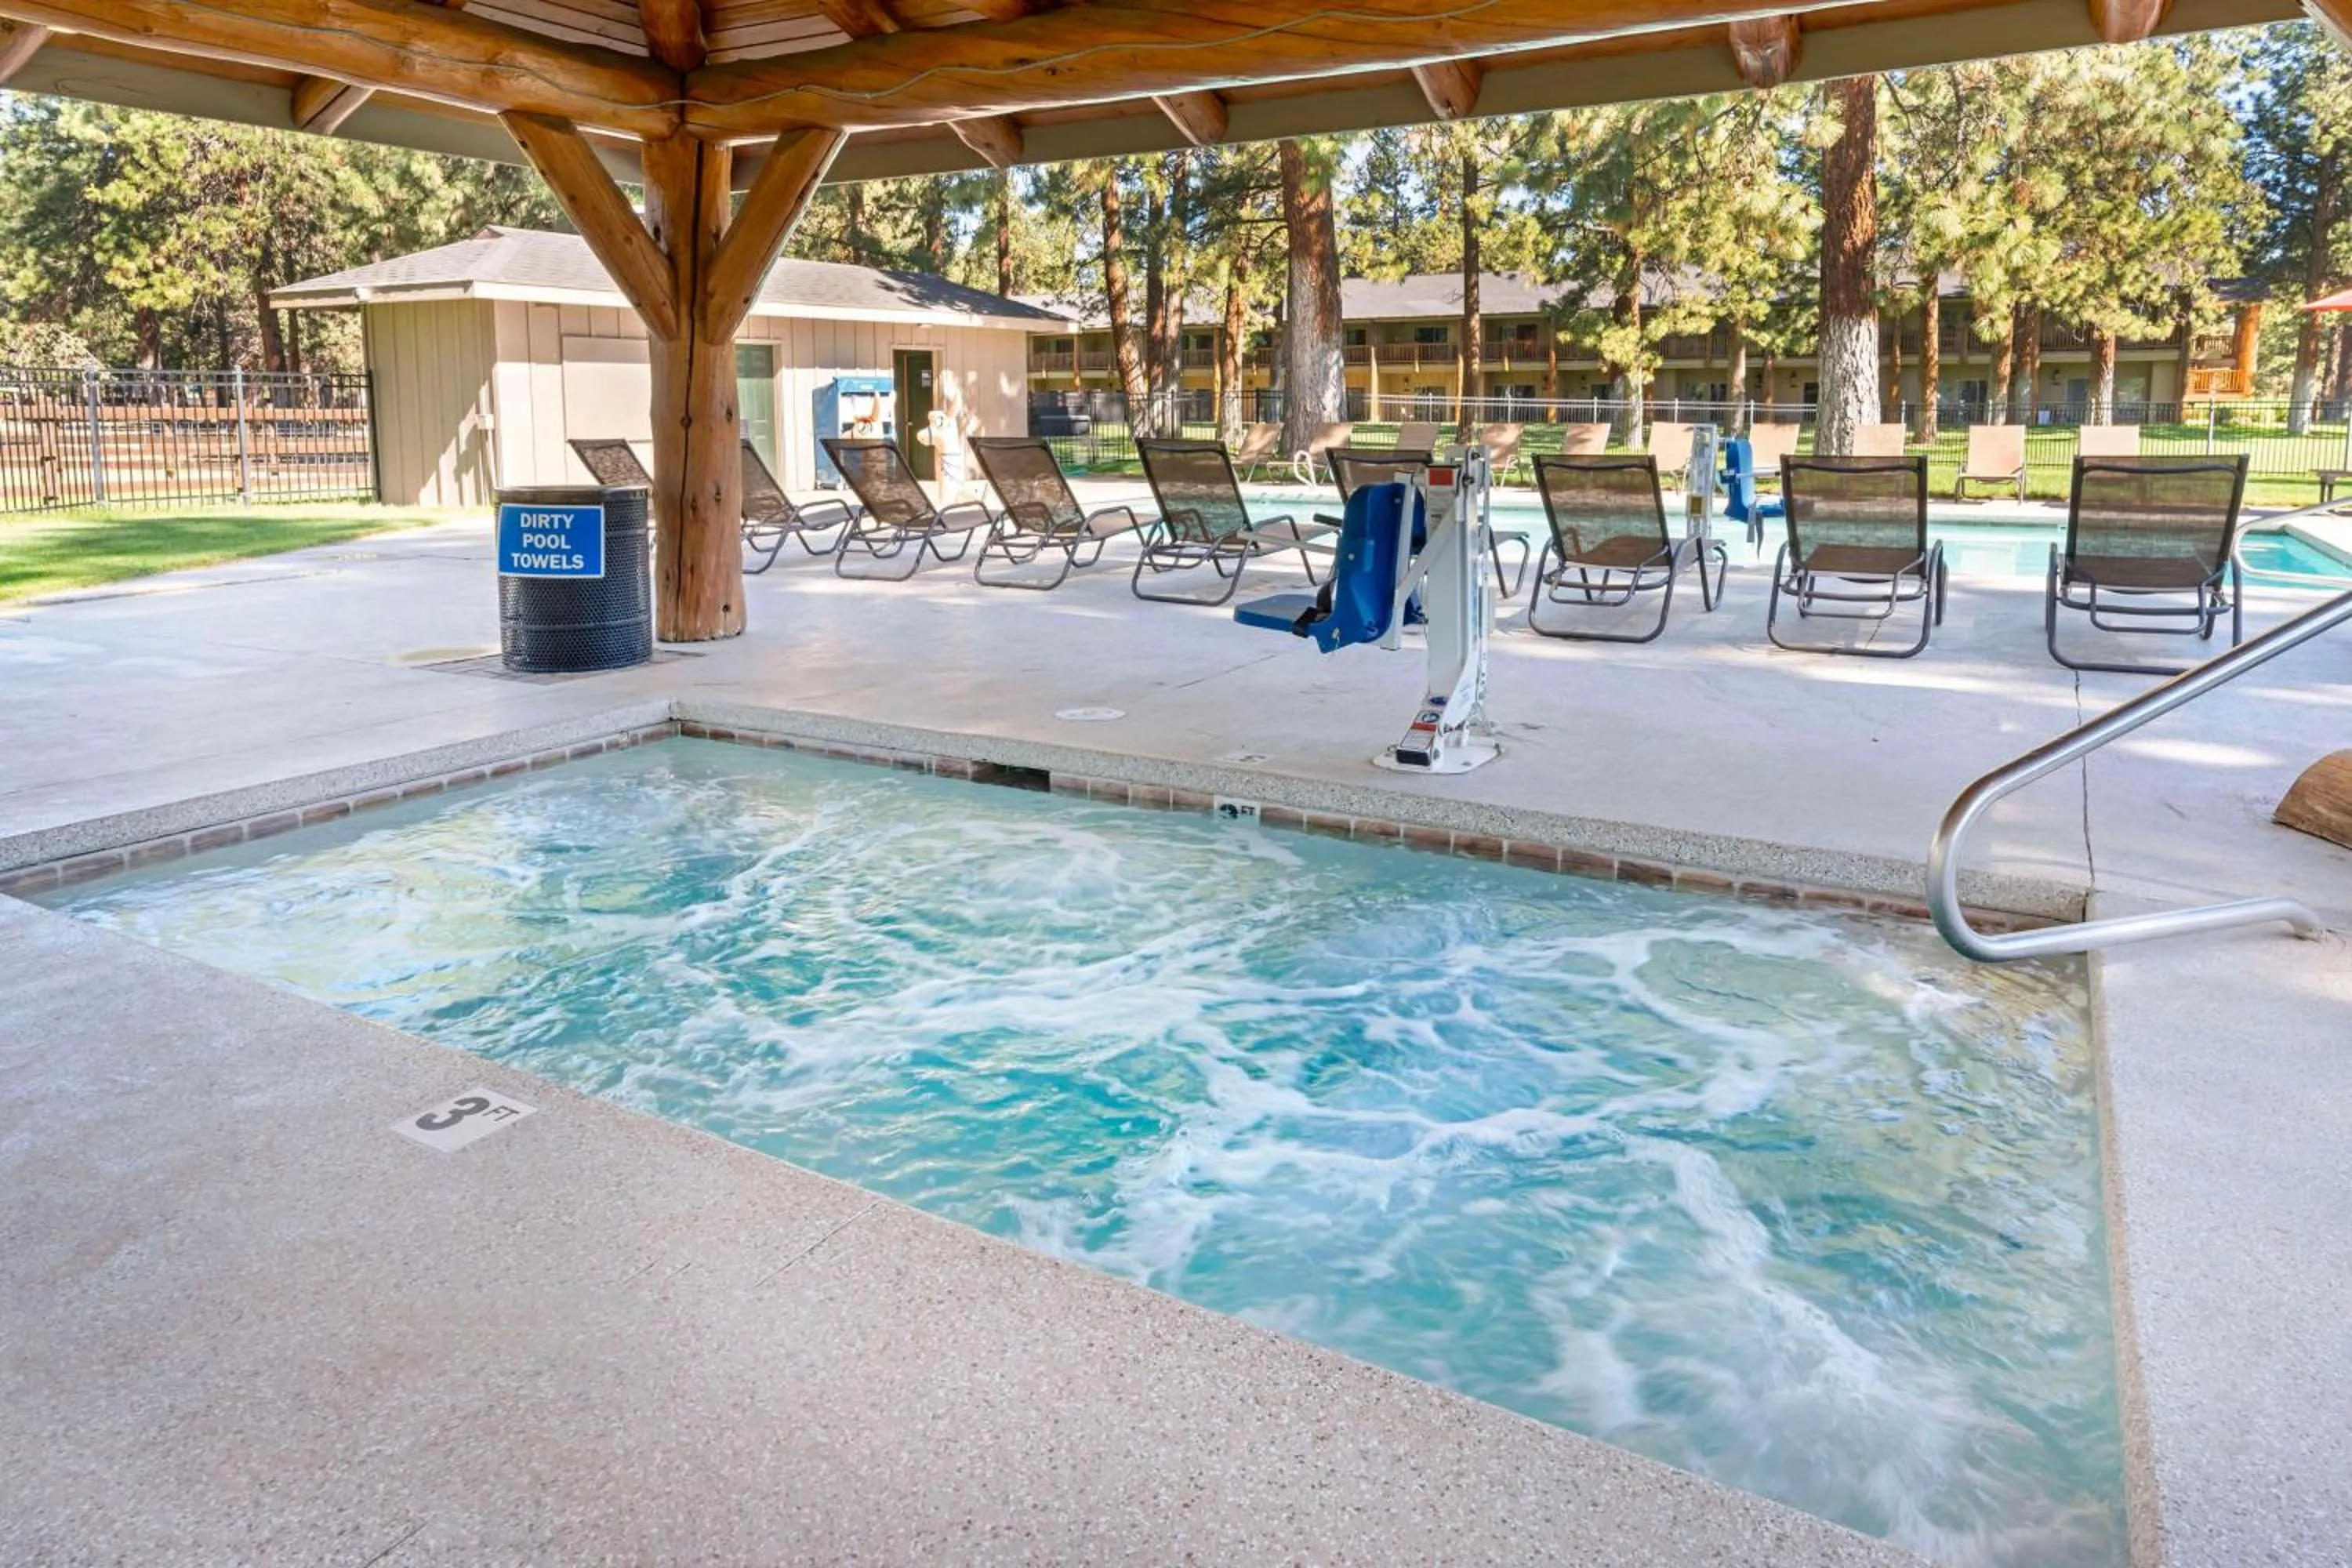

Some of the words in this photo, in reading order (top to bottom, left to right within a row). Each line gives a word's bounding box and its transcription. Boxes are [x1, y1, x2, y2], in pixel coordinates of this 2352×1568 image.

[520, 512, 575, 529] DIRTY
[522, 533, 572, 549] POOL
[511, 553, 585, 569] TOWELS
[416, 1097, 490, 1131] 3
[481, 1105, 521, 1122] FT
